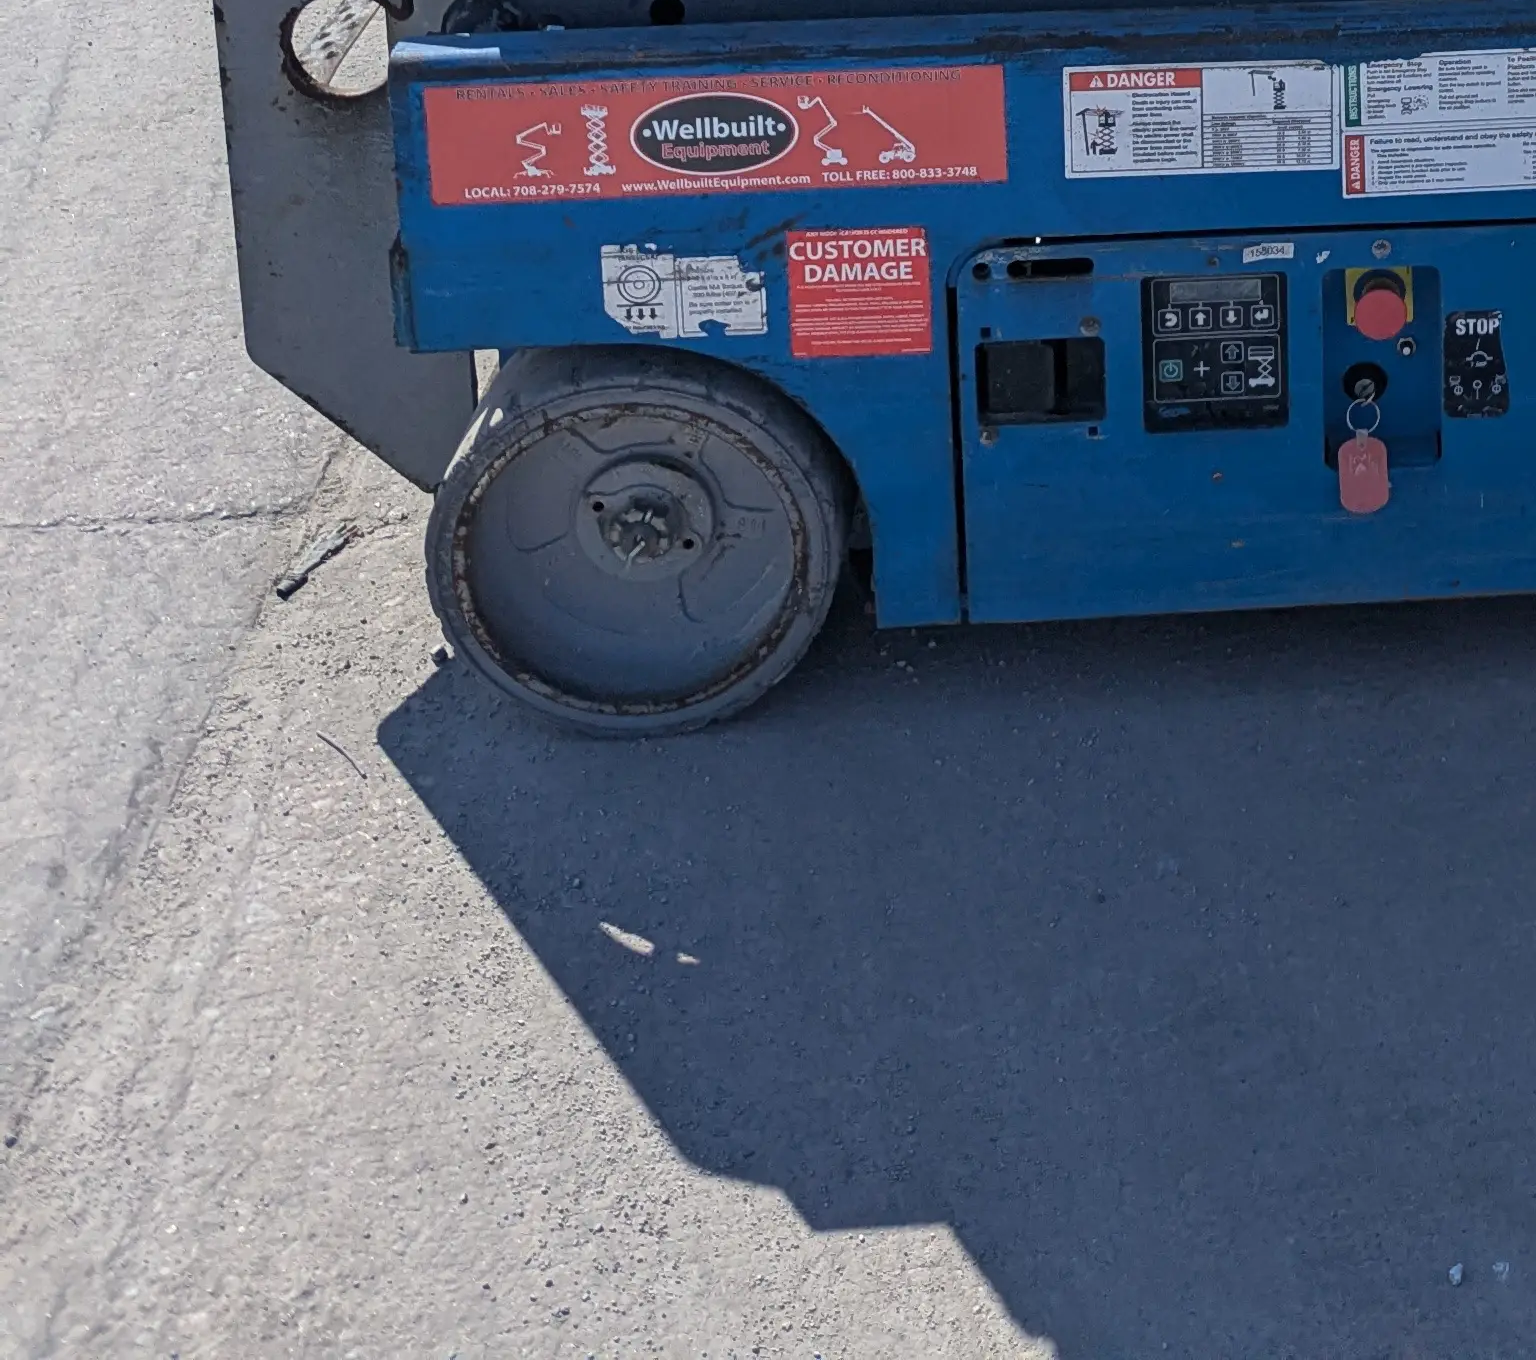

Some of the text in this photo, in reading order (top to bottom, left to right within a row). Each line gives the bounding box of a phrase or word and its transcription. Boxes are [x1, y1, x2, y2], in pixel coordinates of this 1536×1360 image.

[1107, 72, 1176, 89] DANGER
[651, 114, 777, 140] Wellbuilt
[1369, 137, 1394, 145] Failure
[661, 141, 770, 161] Equipment
[1351, 138, 1360, 180] DANGER
[621, 173, 811, 192] www.WellbuiltEquipment.com
[821, 166, 978, 182] TOLL FREE: 800-833-3748
[464, 182, 601, 199] LOCAL: 708-279-7574
[789, 238, 926, 261] CUSTOMER
[804, 261, 913, 283] DAMAGE
[1455, 318, 1500, 336] STOP
